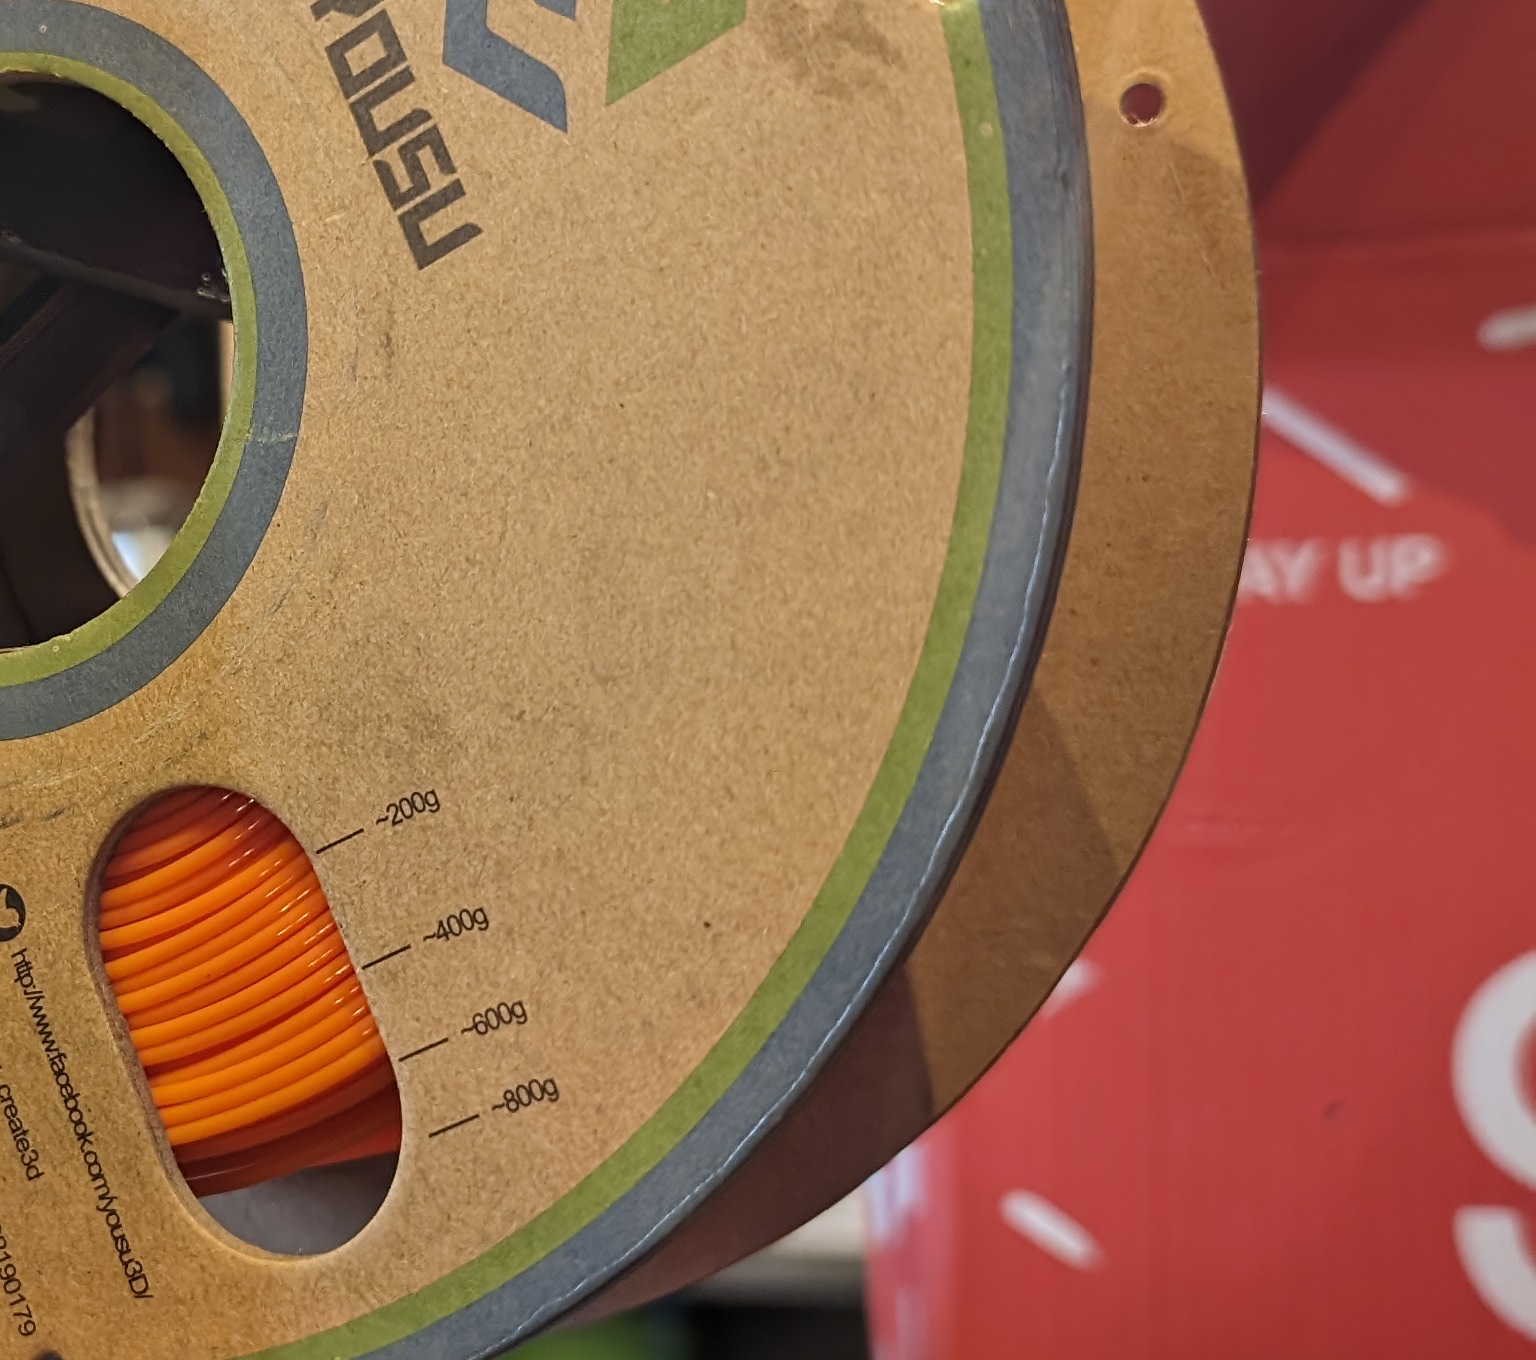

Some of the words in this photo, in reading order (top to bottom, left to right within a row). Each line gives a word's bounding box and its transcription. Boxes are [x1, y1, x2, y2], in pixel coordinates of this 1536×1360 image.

[1336, 533, 1448, 605] UP
[374, 788, 442, 827] ~200g
[421, 905, 490, 944] ~400g
[460, 998, 529, 1038] ~600g
[491, 1075, 560, 1115] ~800g
[10, 946, 154, 1301] http://www.facebook.com/yousu3D/
